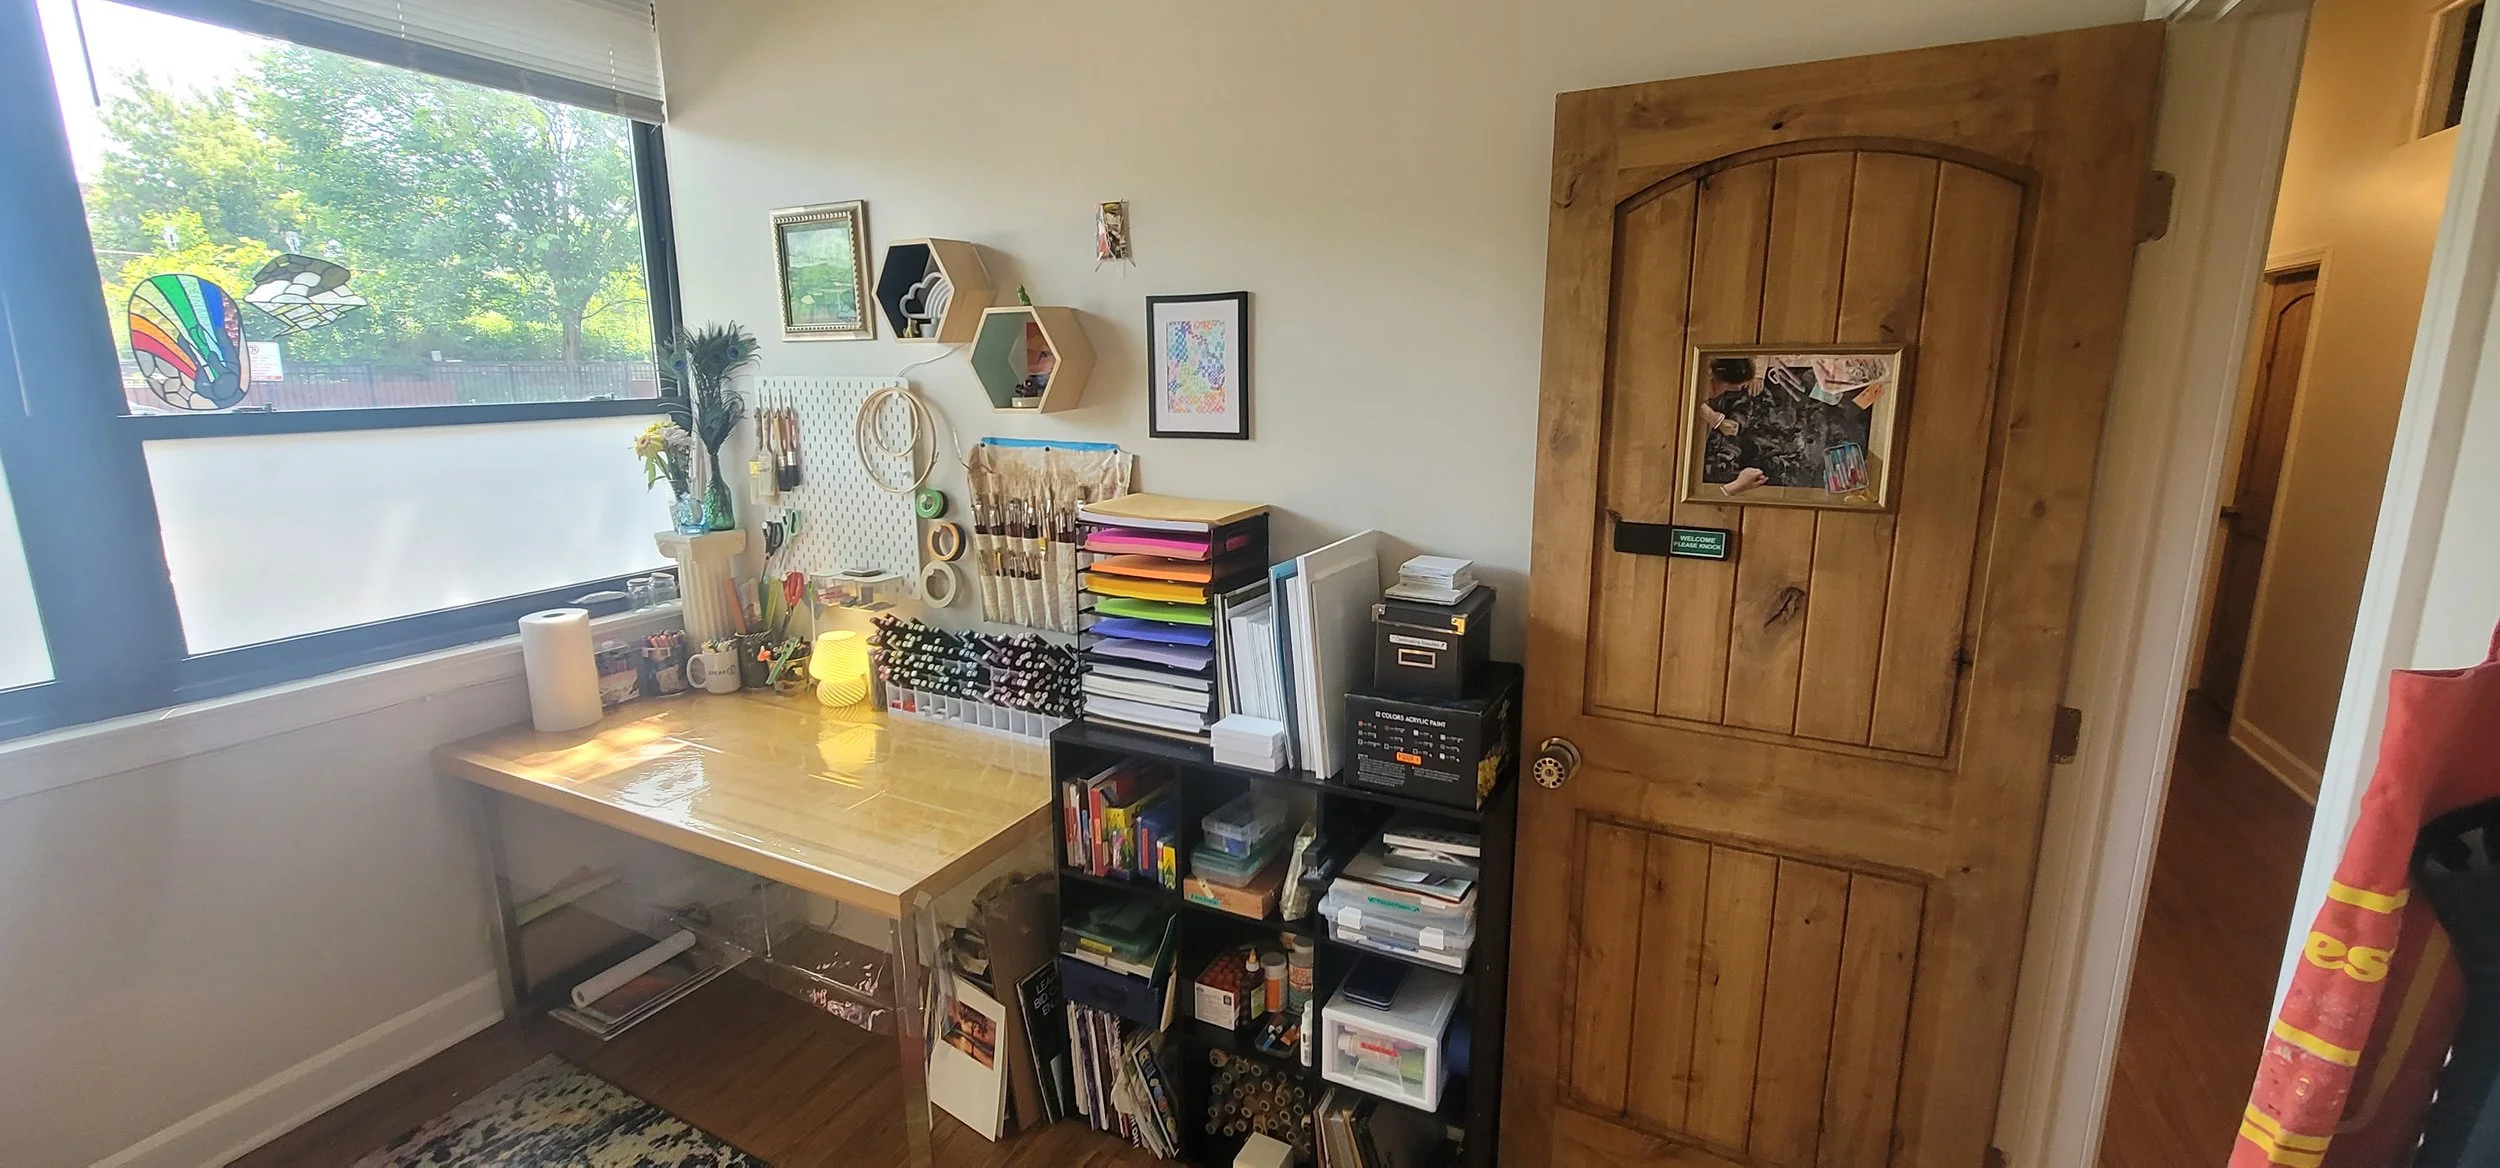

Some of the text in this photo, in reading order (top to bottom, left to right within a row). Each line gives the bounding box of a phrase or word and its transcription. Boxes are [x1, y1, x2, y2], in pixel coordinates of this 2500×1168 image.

[1673, 541, 1698, 549] PLEASE
[1679, 535, 1716, 543] WELCOME
[1381, 712, 1404, 721] COLORS
[1405, 716, 1429, 726] ACRYLIC
[1429, 720, 1446, 728] PAINT
[2304, 931, 2391, 982] es
